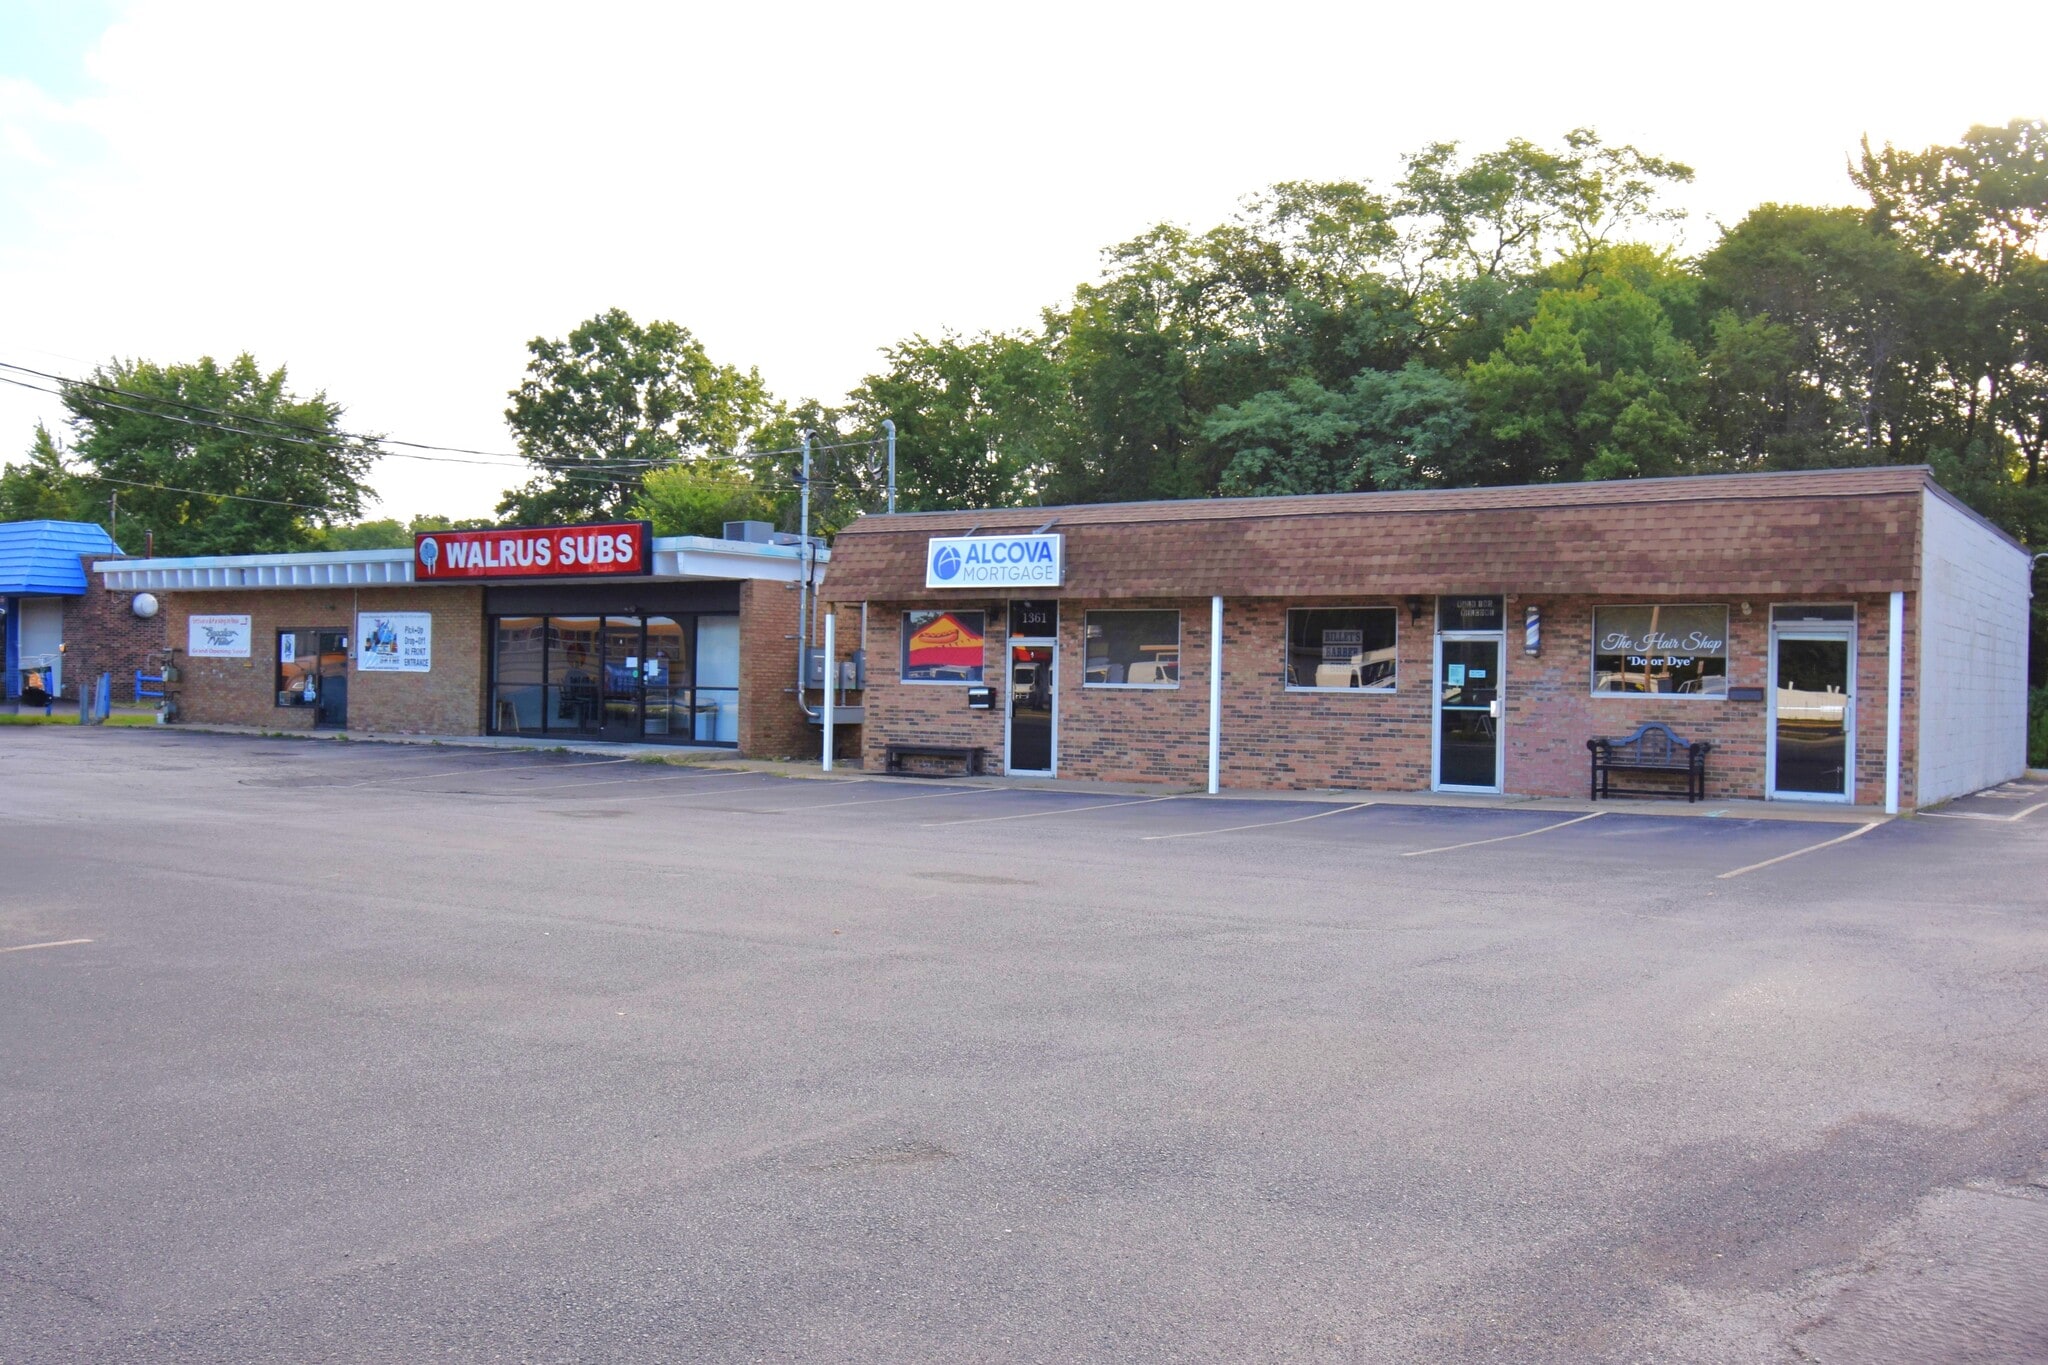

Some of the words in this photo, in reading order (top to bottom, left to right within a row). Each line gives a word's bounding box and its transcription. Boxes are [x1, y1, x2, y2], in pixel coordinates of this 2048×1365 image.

[446, 538, 551, 568] WALRUS
[559, 534, 633, 565] SUBS
[965, 541, 1053, 564] ALCOVA
[963, 565, 1053, 580] MORTGAGE
[1022, 612, 1047, 624] 1361
[1601, 633, 1632, 650] The
[1634, 632, 1680, 652] Hair
[1682, 632, 1722, 654] Shop
[1325, 647, 1359, 658] BARBER
[404, 658, 429, 667] ENTRANCE
[1627, 656, 1648, 666] "Do
[1650, 658, 1664, 666] or
[1667, 656, 1695, 668] Dye"
